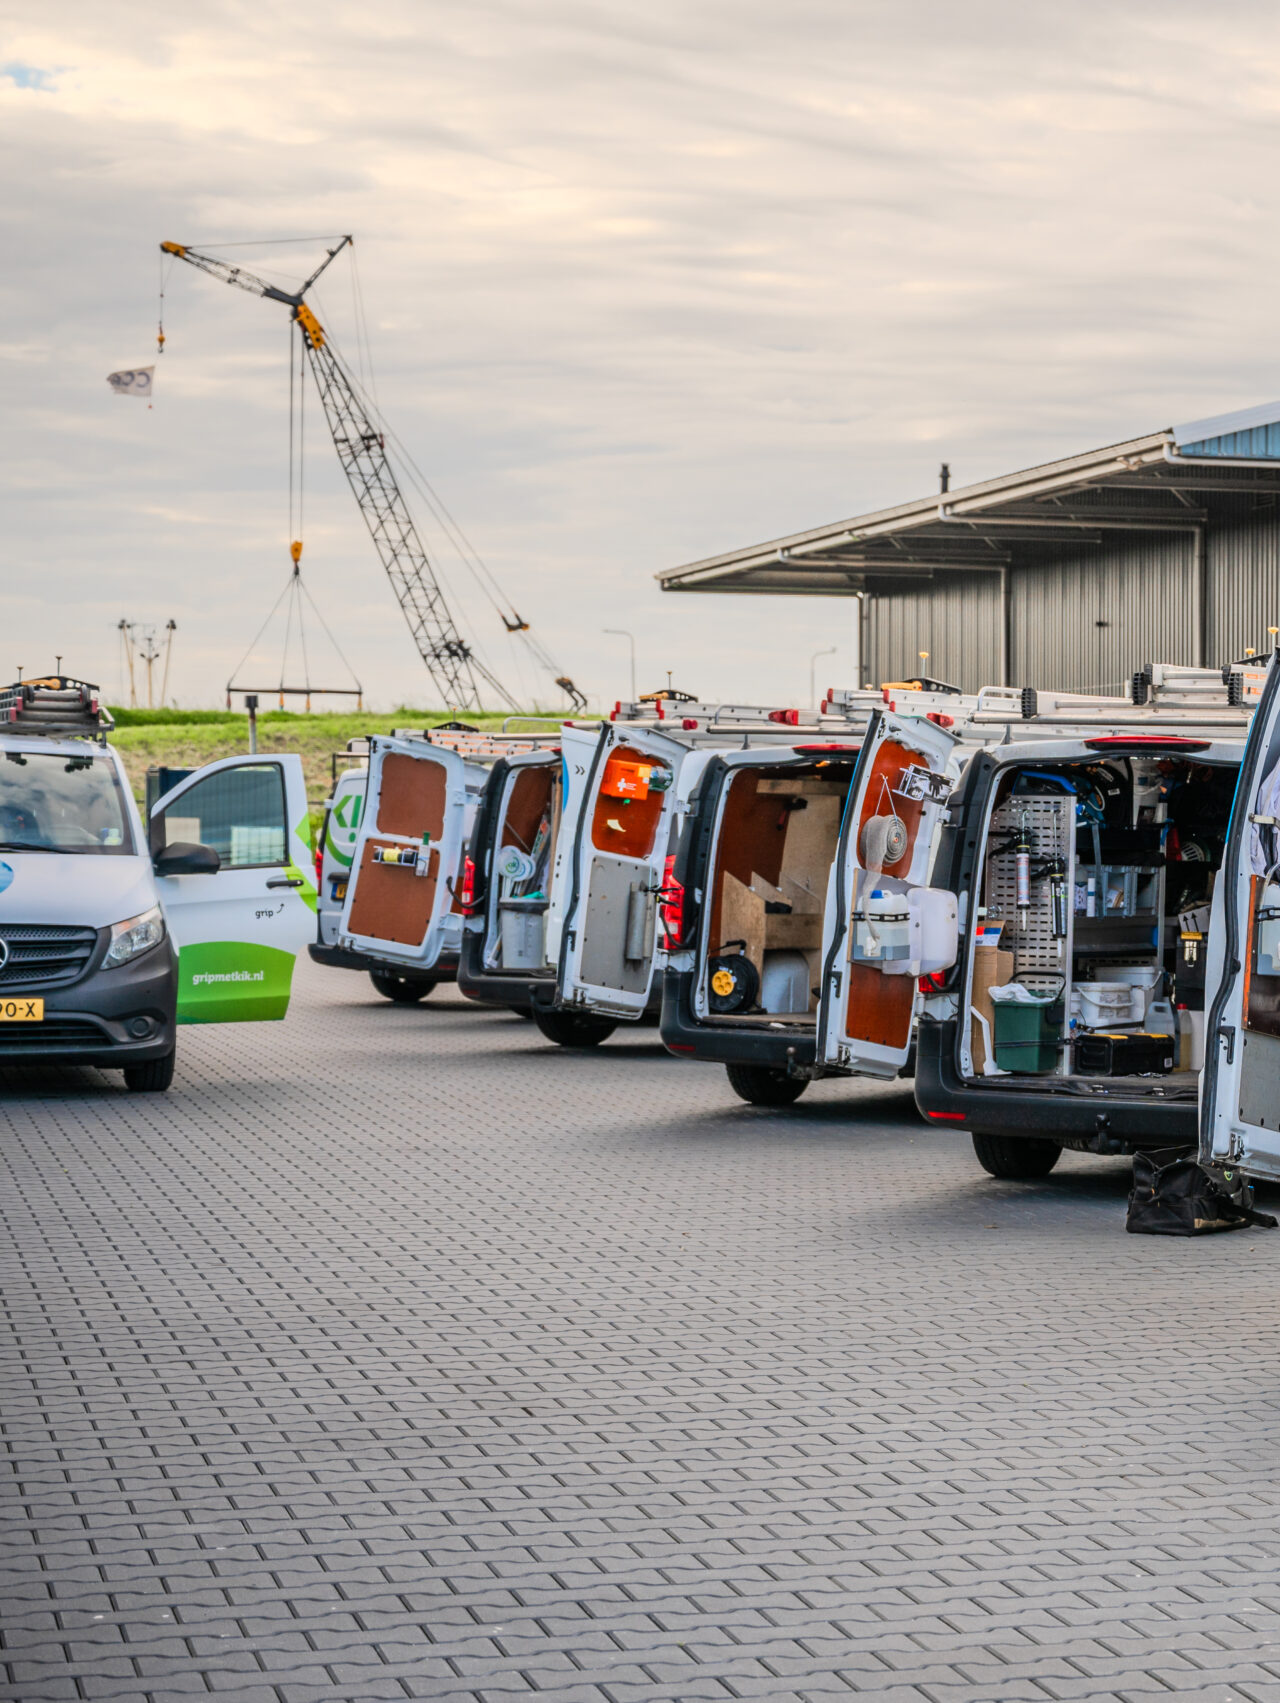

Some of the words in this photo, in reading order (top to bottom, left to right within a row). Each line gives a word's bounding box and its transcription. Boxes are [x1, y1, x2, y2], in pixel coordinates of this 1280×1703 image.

[255, 909, 274, 919] grip
[192, 970, 264, 986] gripmetkik.nl
[0, 1002, 35, 1018] 0-X
